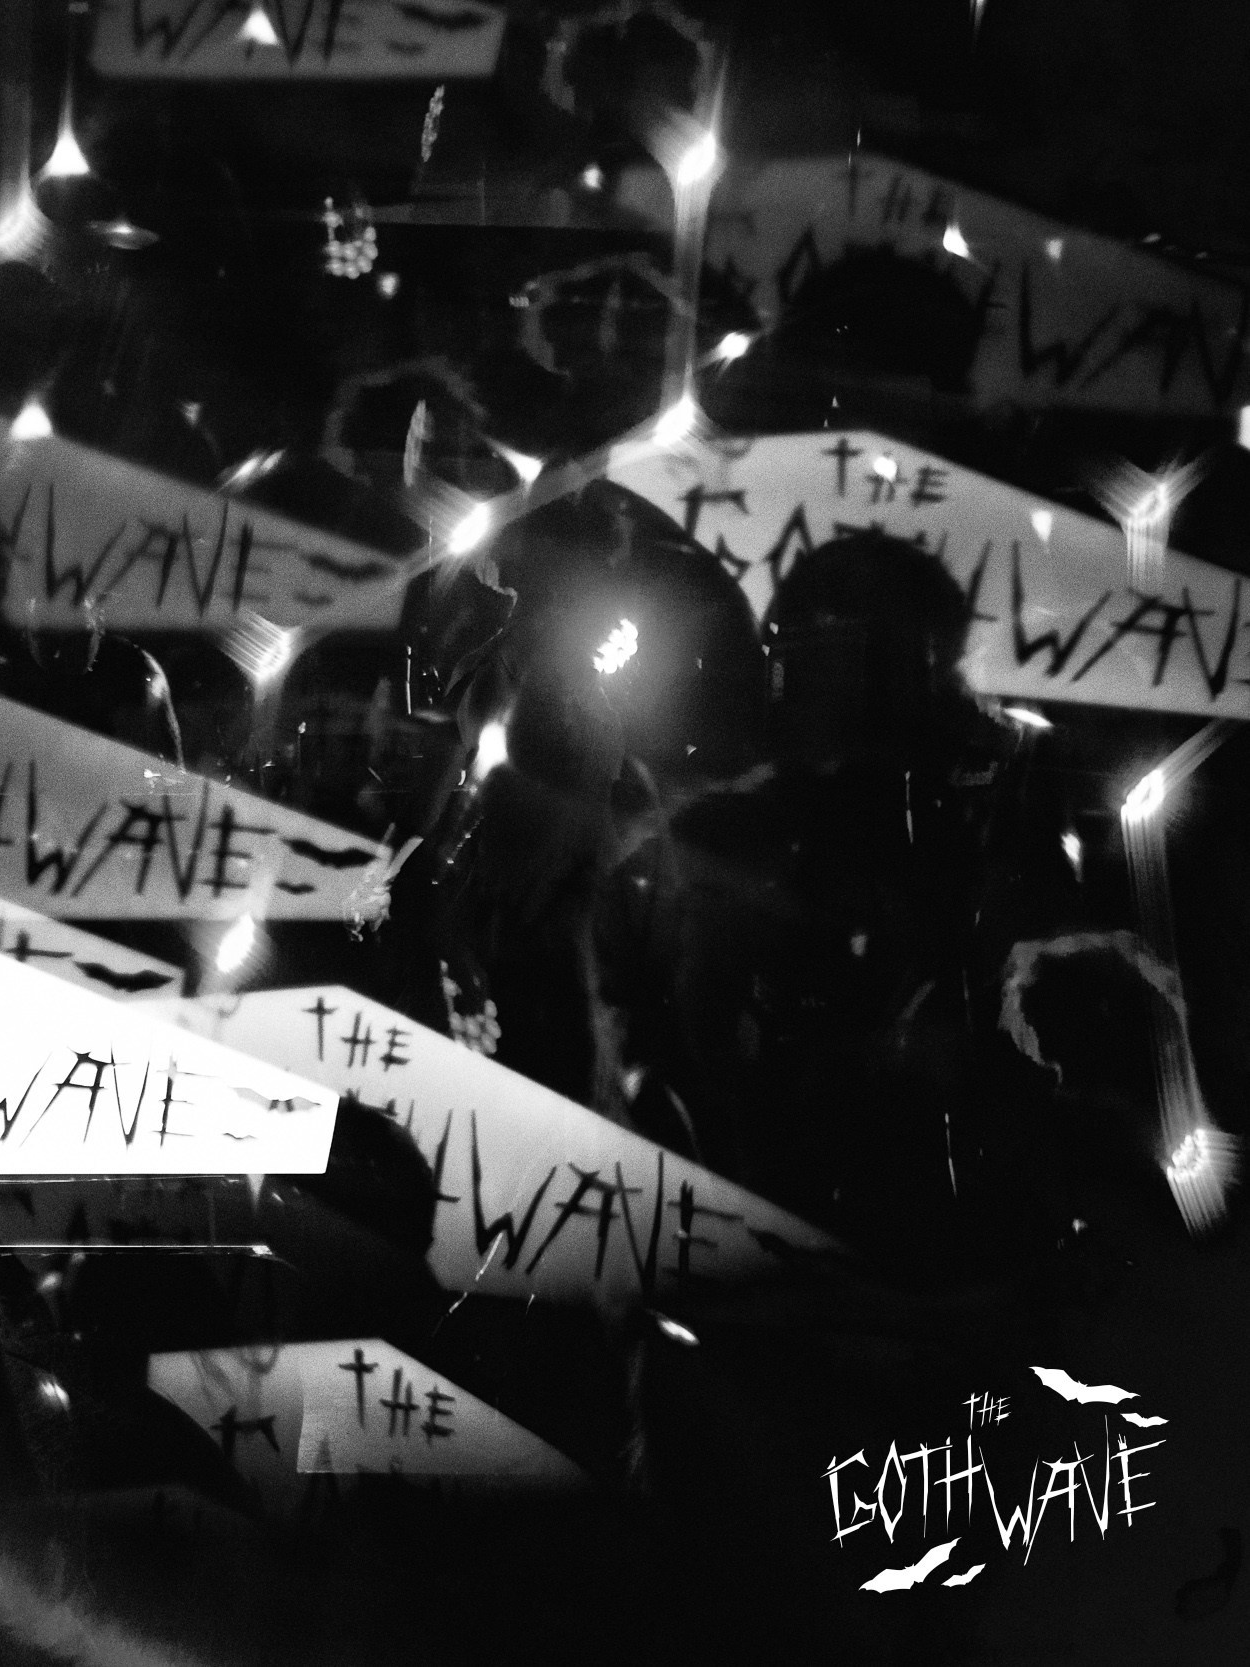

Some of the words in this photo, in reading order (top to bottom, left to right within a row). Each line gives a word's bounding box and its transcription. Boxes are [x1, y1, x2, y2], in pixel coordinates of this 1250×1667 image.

[818, 437, 953, 511] THE
[302, 995, 414, 1070] THE
[339, 1348, 457, 1447] THE
